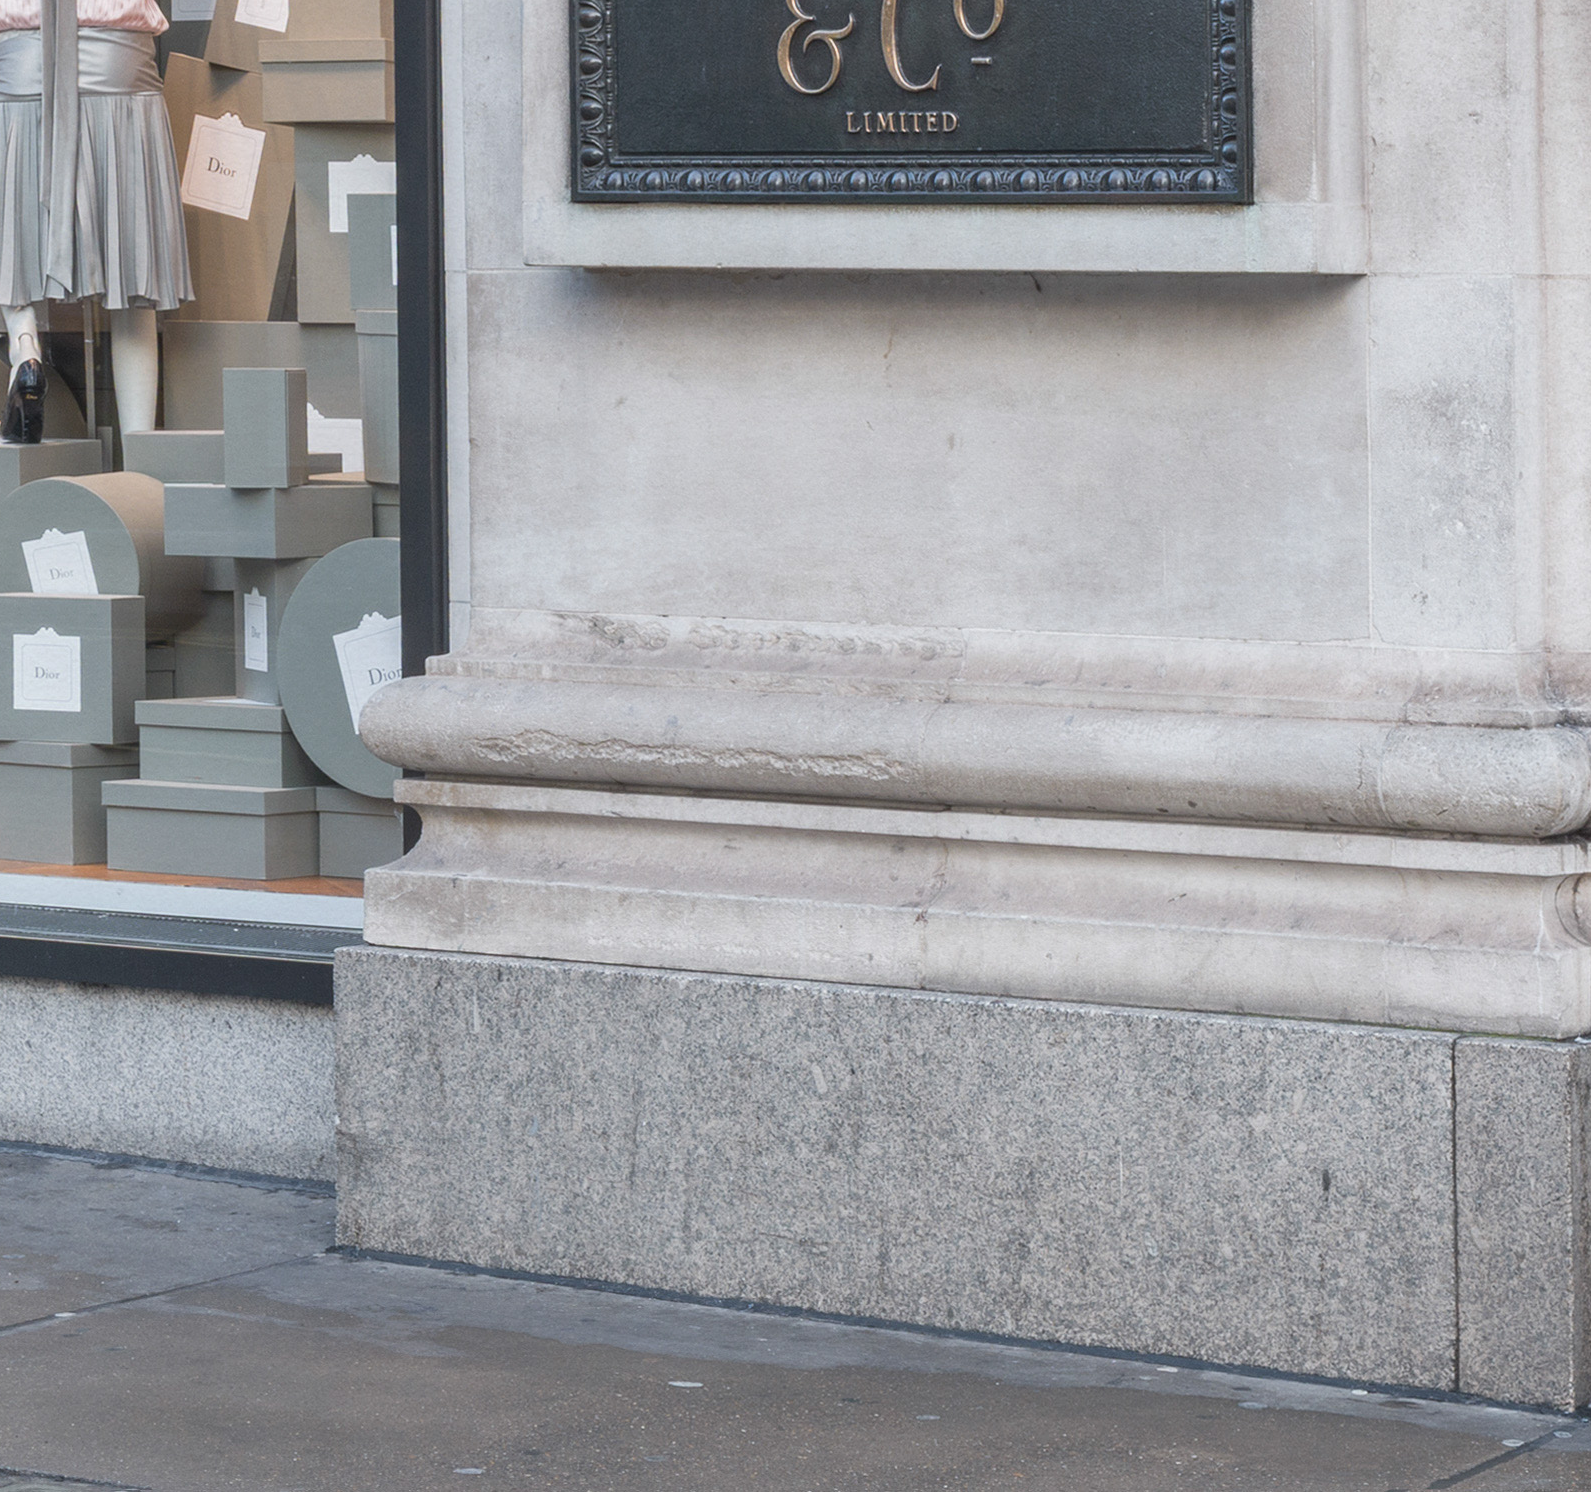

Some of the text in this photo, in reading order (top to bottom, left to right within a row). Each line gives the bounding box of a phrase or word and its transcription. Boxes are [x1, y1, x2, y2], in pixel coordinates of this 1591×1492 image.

[846, 110, 959, 134] LIMITED
[207, 156, 238, 179] Dior
[49, 565, 75, 580] Dior
[34, 666, 61, 680] Dior
